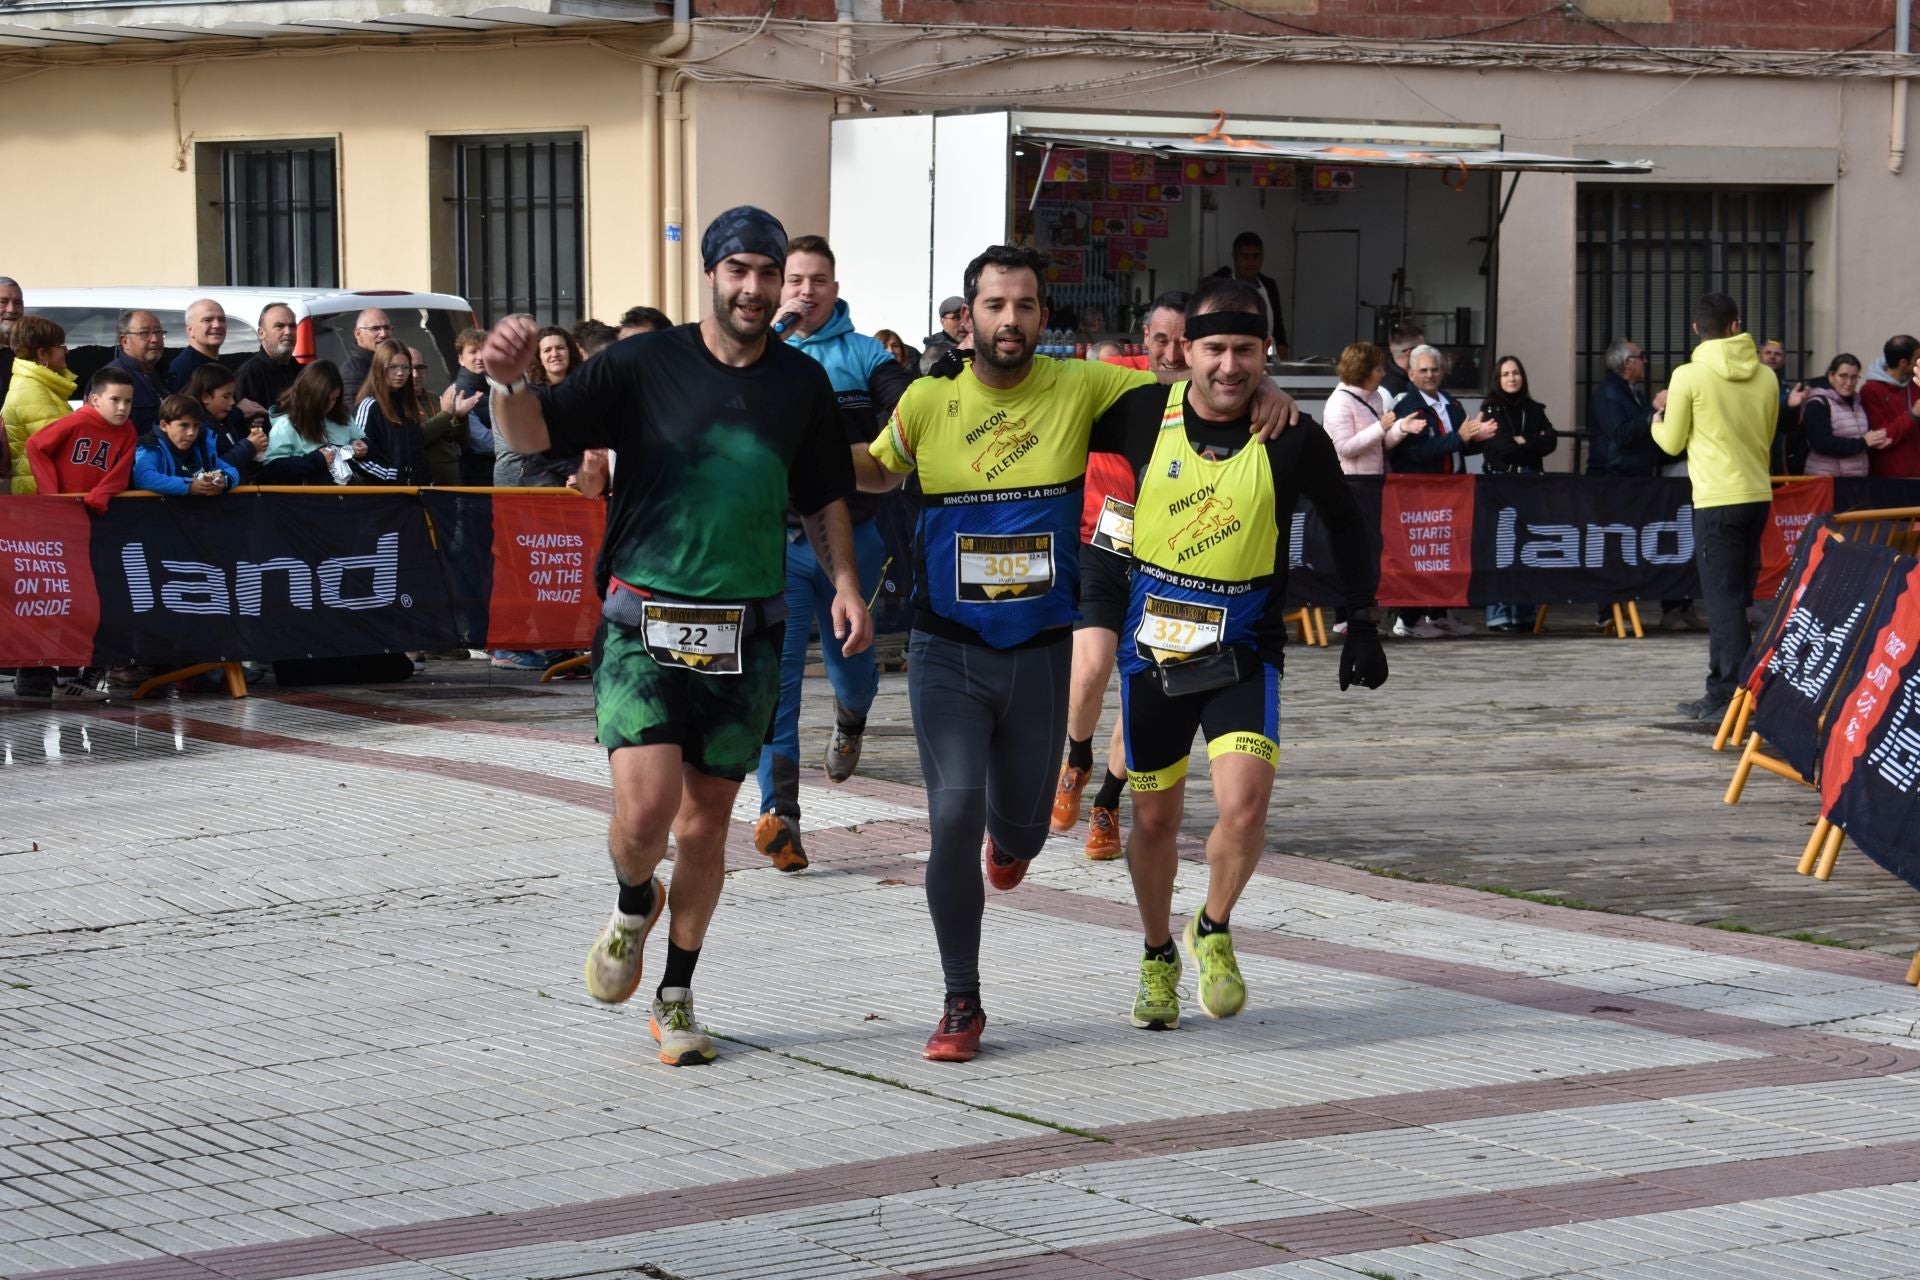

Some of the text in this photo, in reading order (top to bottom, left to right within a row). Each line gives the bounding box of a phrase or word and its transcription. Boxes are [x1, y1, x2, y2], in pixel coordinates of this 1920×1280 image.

[965, 410, 1008, 445] RINCON
[71, 437, 121, 471] GA
[985, 434, 1039, 483] ATLETISMO
[943, 493, 978, 505] RINCÓN
[980, 493, 994, 503] DE
[996, 491, 1022, 501] SOTO
[1028, 489, 1041, 499] LA
[1043, 486, 1067, 497] RIOJA
[1169, 484, 1215, 516] RINCON
[1400, 509, 1453, 524] CHANGES
[1115, 519, 1134, 537] 28
[1409, 527, 1451, 540] STARTS
[1496, 504, 1695, 568] land
[0, 539, 63, 557] CHANGES
[516, 534, 583, 549] CHANGES
[1177, 520, 1241, 564] ATLETISMO
[1410, 543, 1450, 556] ON THE
[14, 557, 66, 575] STARTS
[530, 551, 582, 566] STARTS
[984, 556, 1029, 577] 305
[1415, 559, 1450, 572] INSIDE
[529, 569, 583, 585] ON THE
[1166, 575, 1178, 585] DE
[1180, 578, 1206, 590] SOTO
[1212, 583, 1224, 593] LA
[15, 578, 71, 595] ON THE
[537, 588, 582, 604] INSIDE
[16, 599, 72, 617] INSIDE
[679, 626, 708, 648] 22
[1153, 619, 1197, 645] 327
[1236, 736, 1273, 754] RINCÓN
[1250, 746, 1271, 760] SOTO
